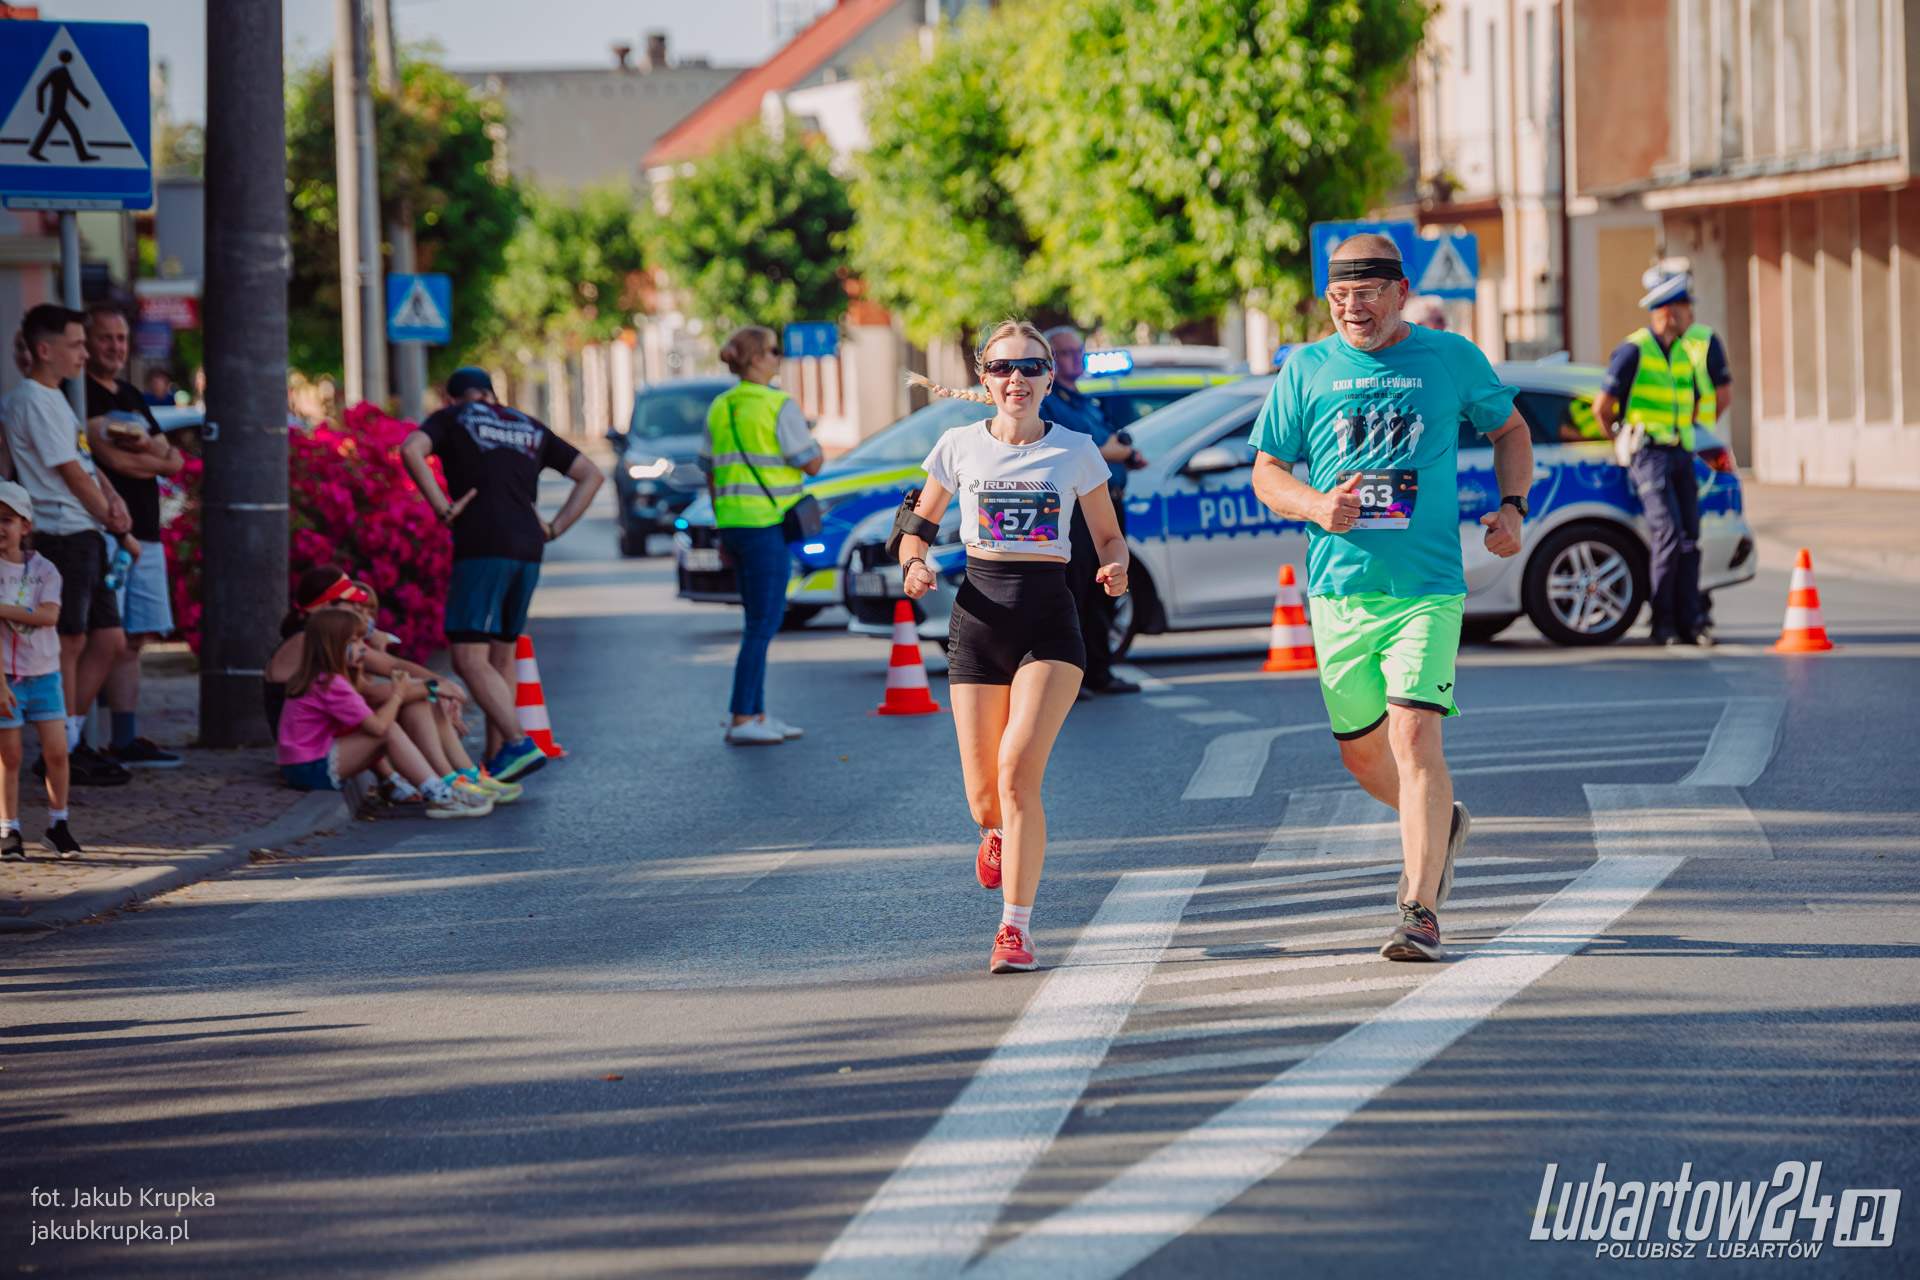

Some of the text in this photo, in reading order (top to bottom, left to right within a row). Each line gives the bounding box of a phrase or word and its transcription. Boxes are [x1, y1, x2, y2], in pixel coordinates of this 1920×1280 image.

[985, 481, 1018, 491] RUN
[1359, 484, 1394, 508] 63
[1003, 508, 1038, 532] 57
